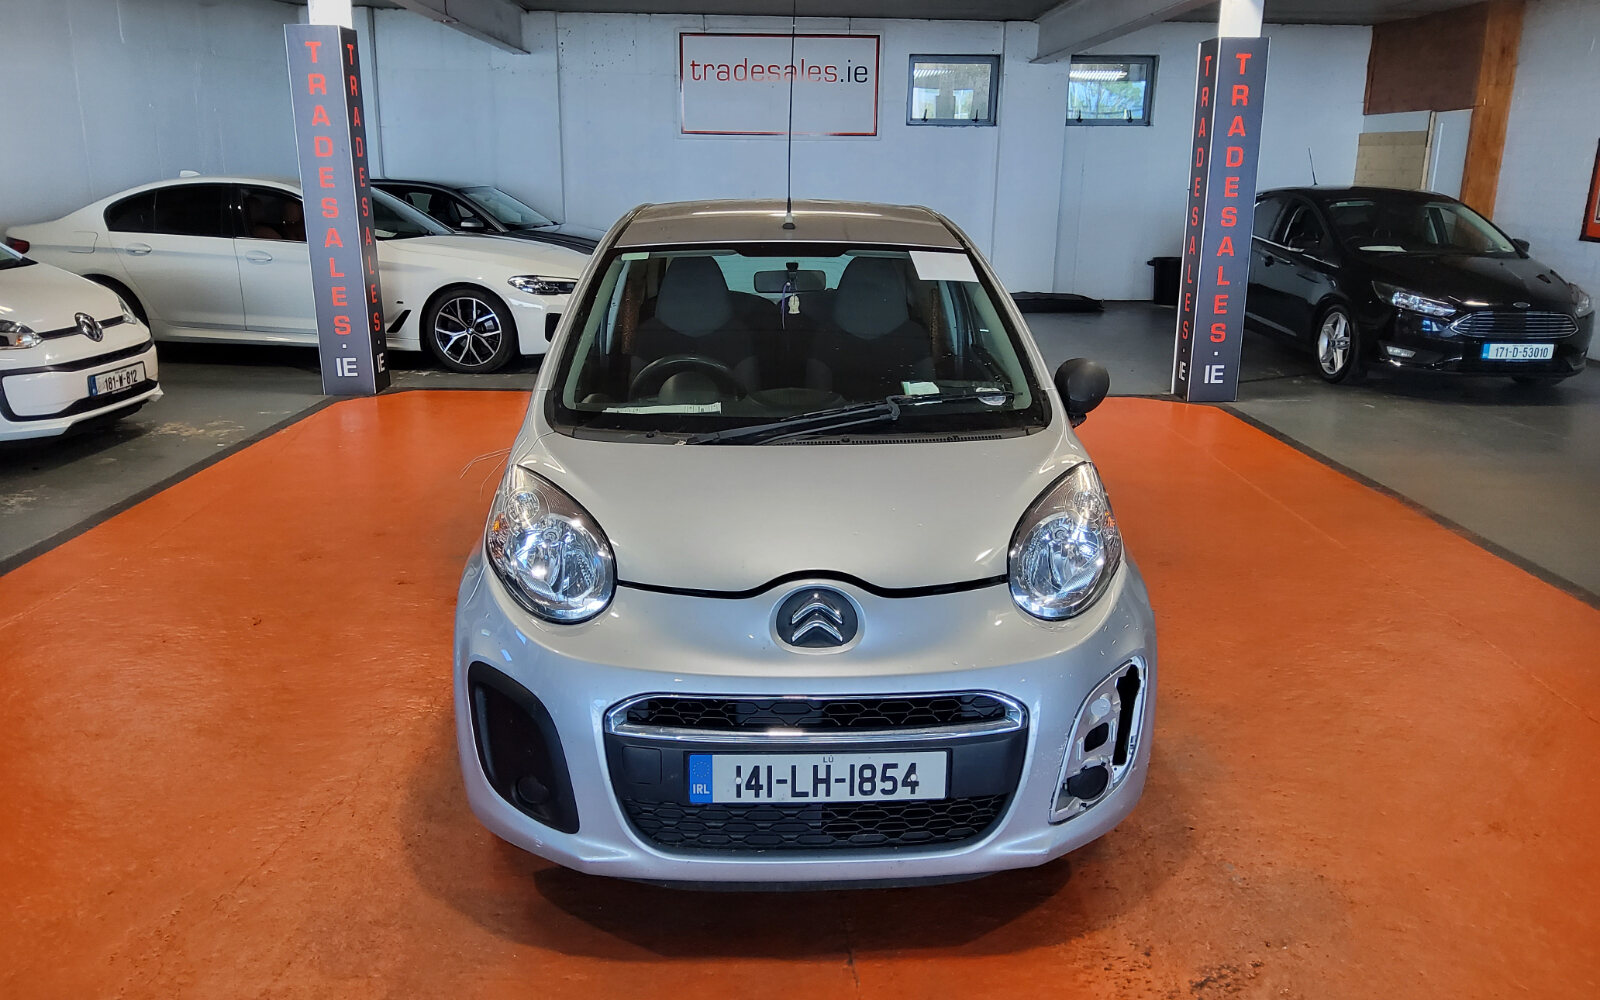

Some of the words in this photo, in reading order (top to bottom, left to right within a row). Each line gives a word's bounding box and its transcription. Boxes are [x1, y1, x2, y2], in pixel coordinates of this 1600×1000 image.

[689, 57, 868, 83] tradesales.ie
[1495, 346, 1549, 358] 171-D-53010
[104, 369, 138, 391] 181-W-812
[692, 784, 710, 795] IRL
[735, 762, 920, 798] 141-LH-1854
